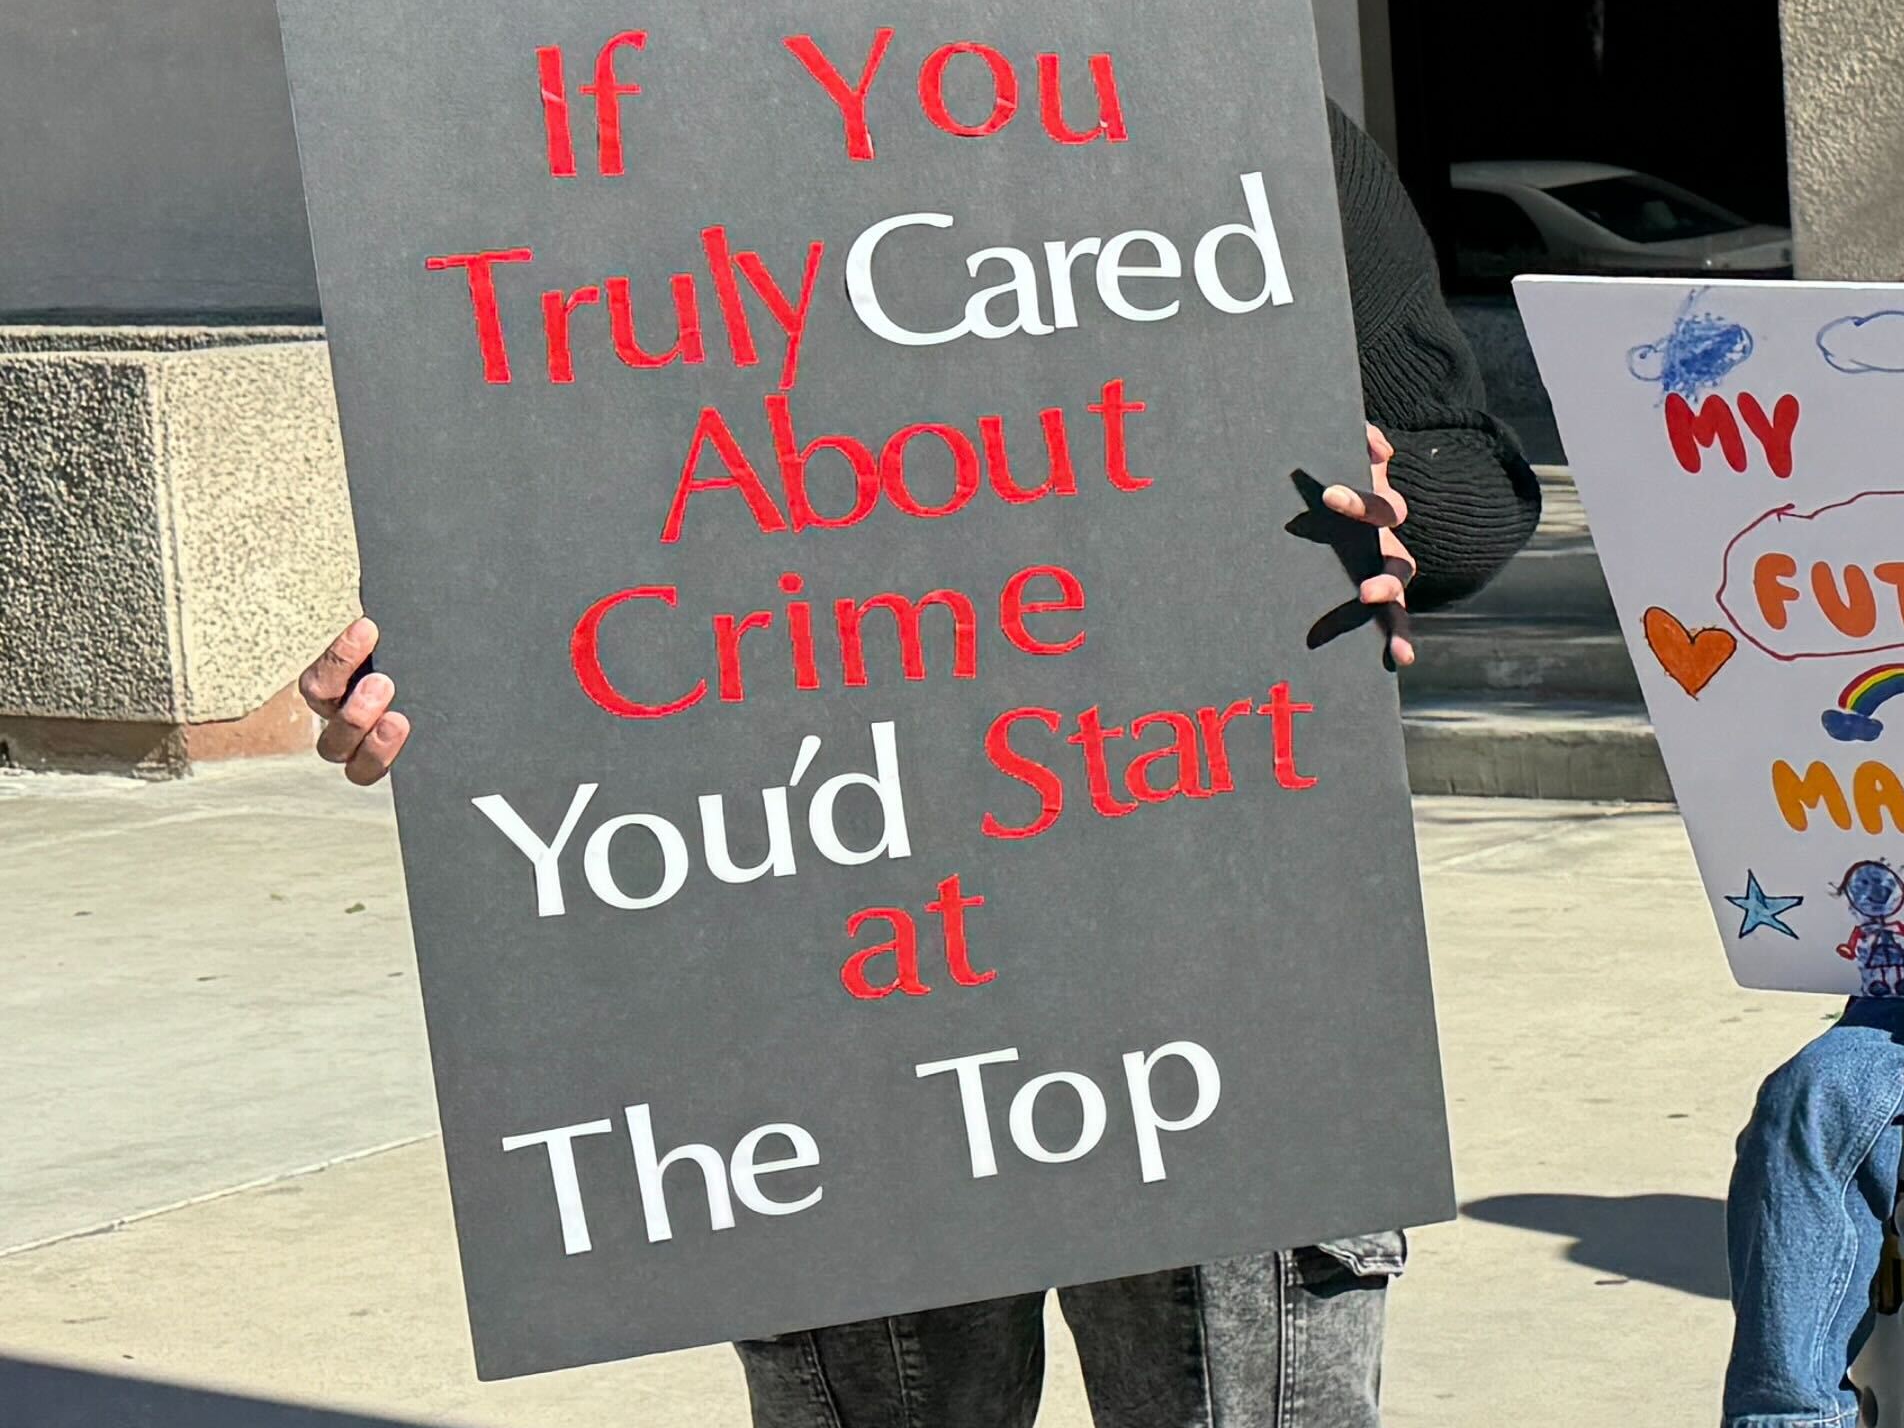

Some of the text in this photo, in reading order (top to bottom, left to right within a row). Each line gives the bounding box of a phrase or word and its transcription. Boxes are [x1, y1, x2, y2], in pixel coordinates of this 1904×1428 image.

[536, 28, 1128, 177] If You
[426, 172, 1293, 388] Truly Cared
[661, 375, 1152, 544] About
[1667, 394, 1798, 477] MY
[571, 565, 1085, 719] Crime
[472, 682, 1318, 916] You'd Start
[841, 875, 996, 999] at
[502, 1041, 1220, 1254] The Top
